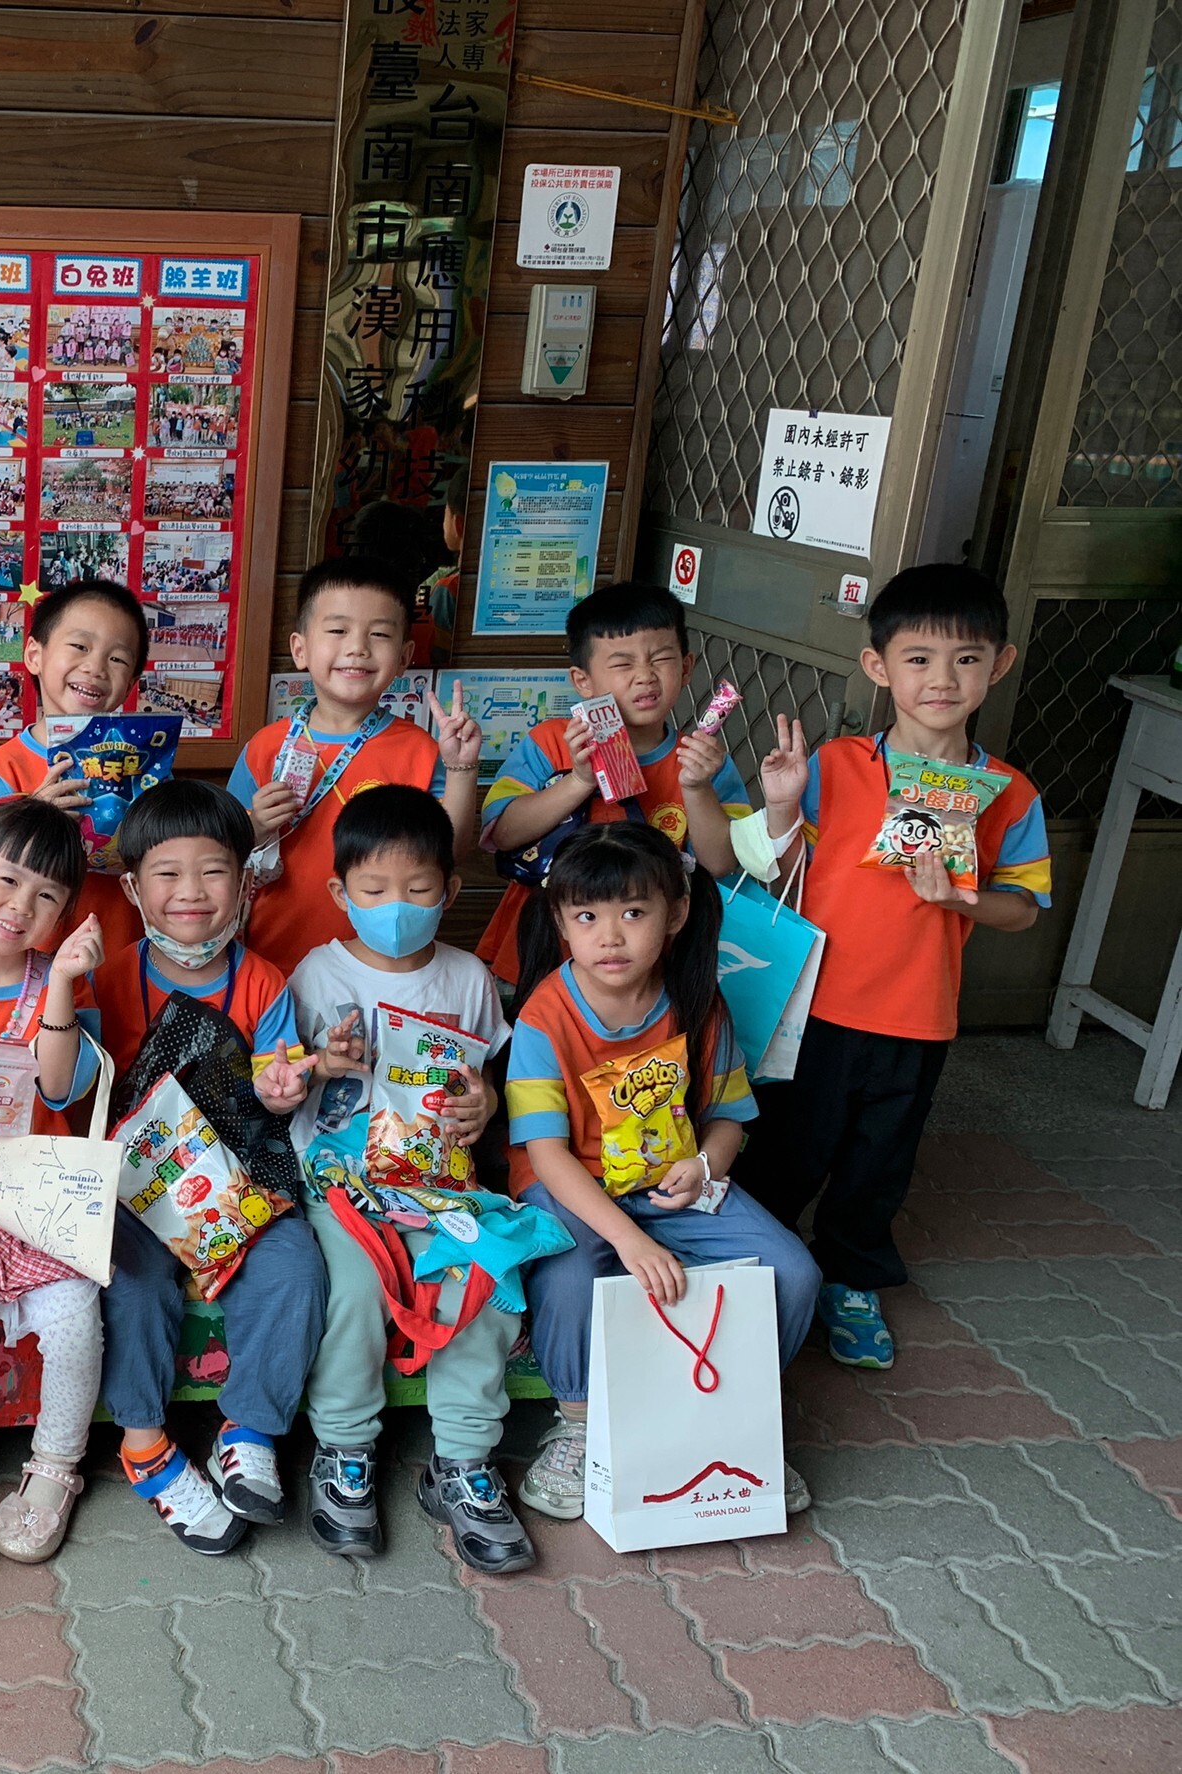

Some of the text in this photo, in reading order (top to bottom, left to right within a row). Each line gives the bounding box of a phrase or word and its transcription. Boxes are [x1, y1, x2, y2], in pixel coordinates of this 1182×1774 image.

[61, 263, 135, 288] 白兔班
[165, 265, 239, 291] 綿羊班
[783, 424, 869, 452] 園內未經許可
[772, 456, 870, 490] 禁止錄音、錄影
[844, 580, 861, 603] 拉
[587, 703, 618, 726] CITY
[90, 741, 138, 753] LUCKY STARS
[81, 755, 142, 783] 滿天星
[919, 769, 973, 791] 旺仔
[901, 784, 979, 813] 小饅頭
[613, 1059, 679, 1107] Cheetos
[128, 1121, 173, 1169] ドデカイ
[58, 1172, 97, 1183] Geminid
[76, 1183, 102, 1192] Meteor
[62, 1188, 87, 1196] Shower
[690, 1487, 752, 1505] 玉山大曲
[693, 1505, 752, 1519] YUSHAN DAQU
